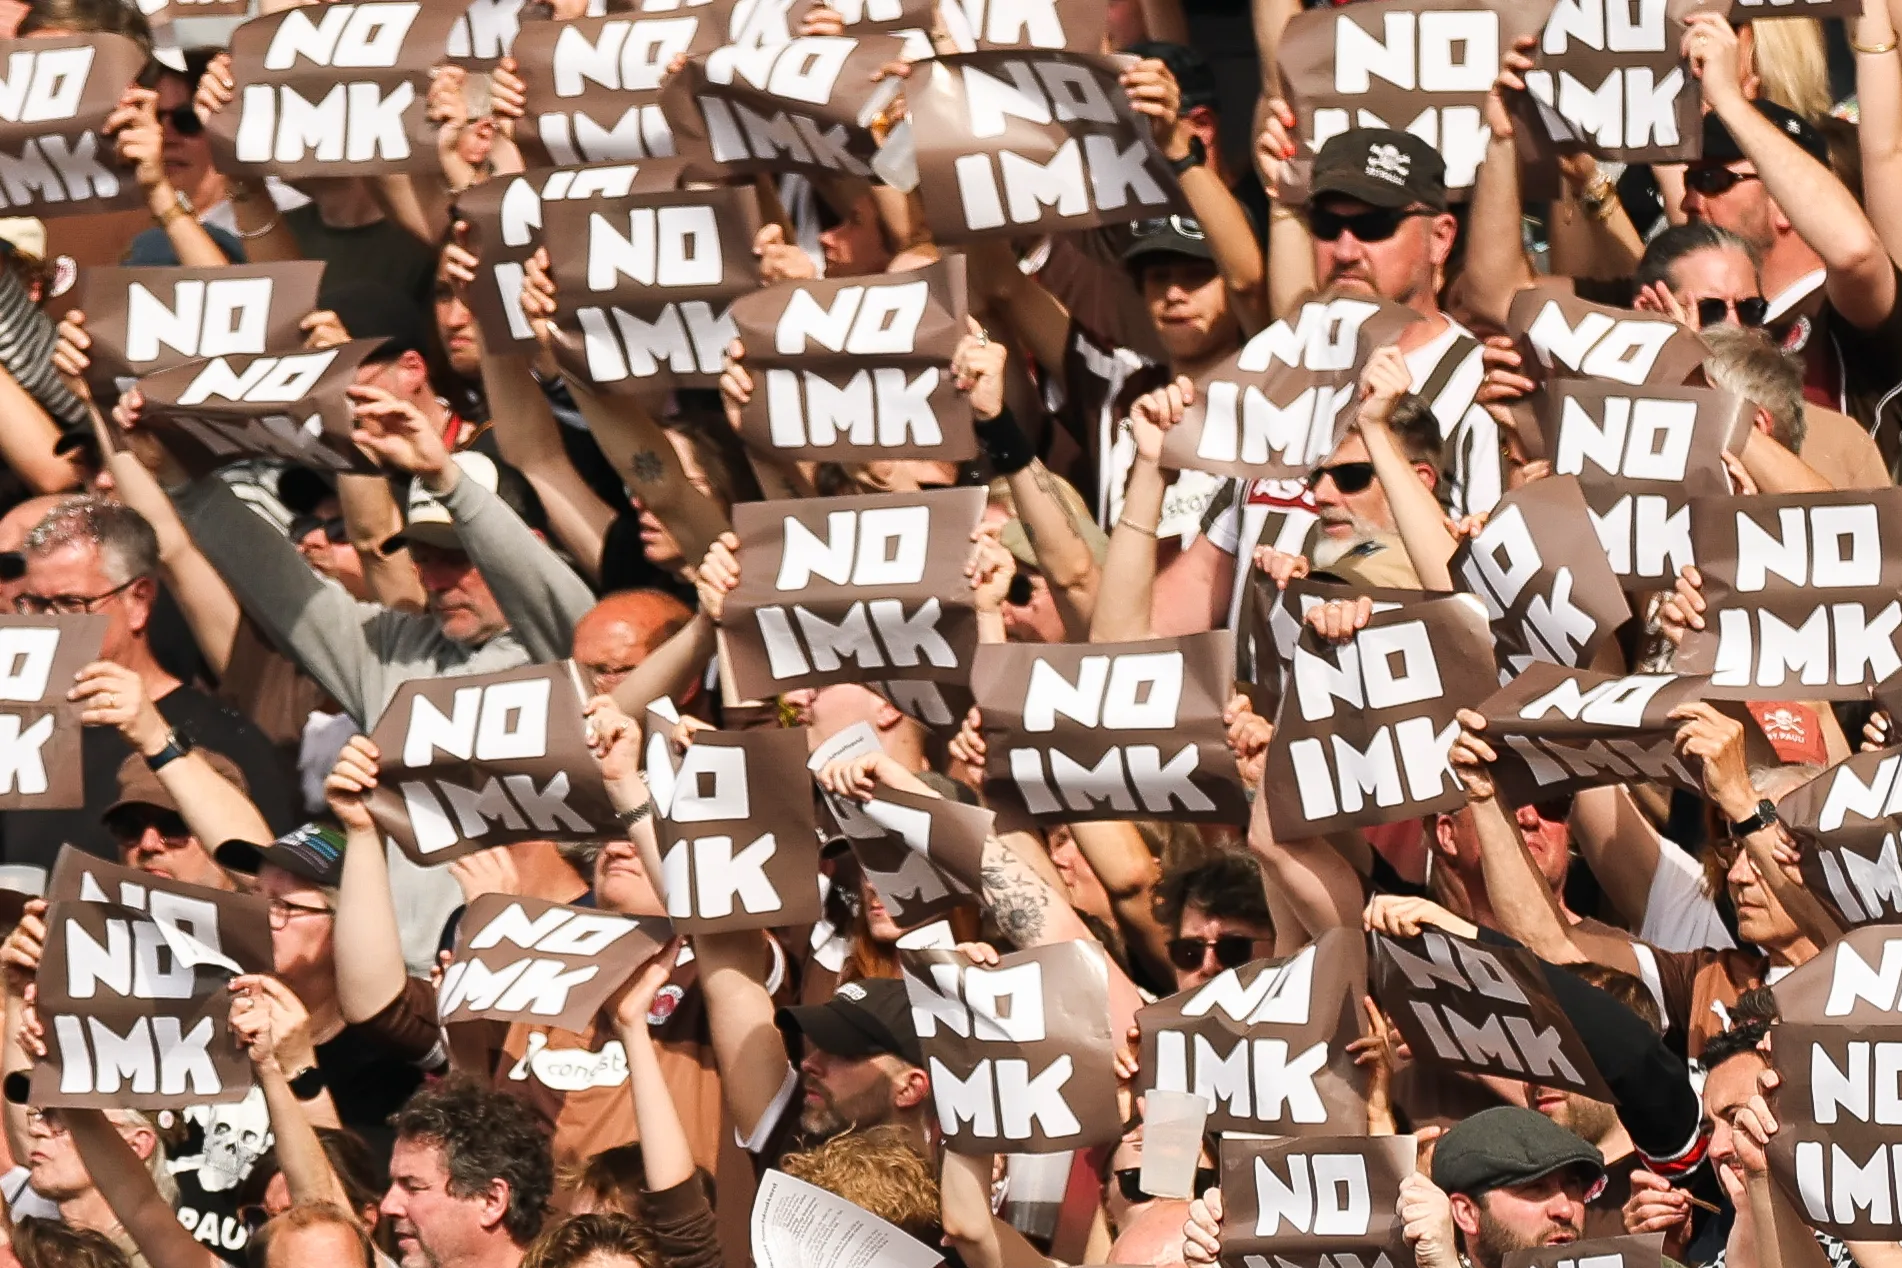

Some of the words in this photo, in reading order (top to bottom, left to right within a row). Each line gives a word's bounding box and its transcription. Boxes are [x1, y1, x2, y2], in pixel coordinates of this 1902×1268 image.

[265, 3, 420, 69] NO
[554, 17, 698, 97] NO
[1334, 10, 1497, 93] NO
[1544, 0, 1667, 54] NO
[706, 34, 859, 103] NO
[961, 59, 1118, 139] NO
[1525, 66, 1684, 150] IMK
[238, 81, 414, 162] IMK
[708, 97, 876, 176] IMK
[955, 134, 1170, 231] IMK
[589, 206, 723, 292] NO
[127, 278, 273, 362] NO
[775, 281, 929, 355] NO
[1239, 300, 1379, 372] NO
[1528, 300, 1678, 386] NO
[178, 349, 339, 404] NO
[767, 367, 942, 448] IMK
[1555, 395, 1698, 482] NO
[776, 506, 930, 591] NO
[1736, 503, 1882, 592] NO
[757, 598, 957, 680] IMK
[1297, 619, 1444, 722] NO
[1711, 602, 1902, 686] IMK
[403, 678, 551, 768] NO
[1024, 651, 1184, 732] NO
[1519, 675, 1678, 727] NO
[1009, 744, 1216, 814] IMK
[1291, 718, 1464, 820] IMK
[1503, 734, 1700, 792] IMK
[400, 772, 595, 854] IMK
[469, 902, 639, 956] NO
[1394, 933, 1531, 1005] NO
[439, 958, 599, 1016] IMK
[903, 959, 1046, 1042] NO
[55, 1014, 222, 1095] IMK
[1155, 1029, 1327, 1124] IMK
[1409, 1000, 1586, 1084] IMK
[1255, 1153, 1369, 1236] NO
